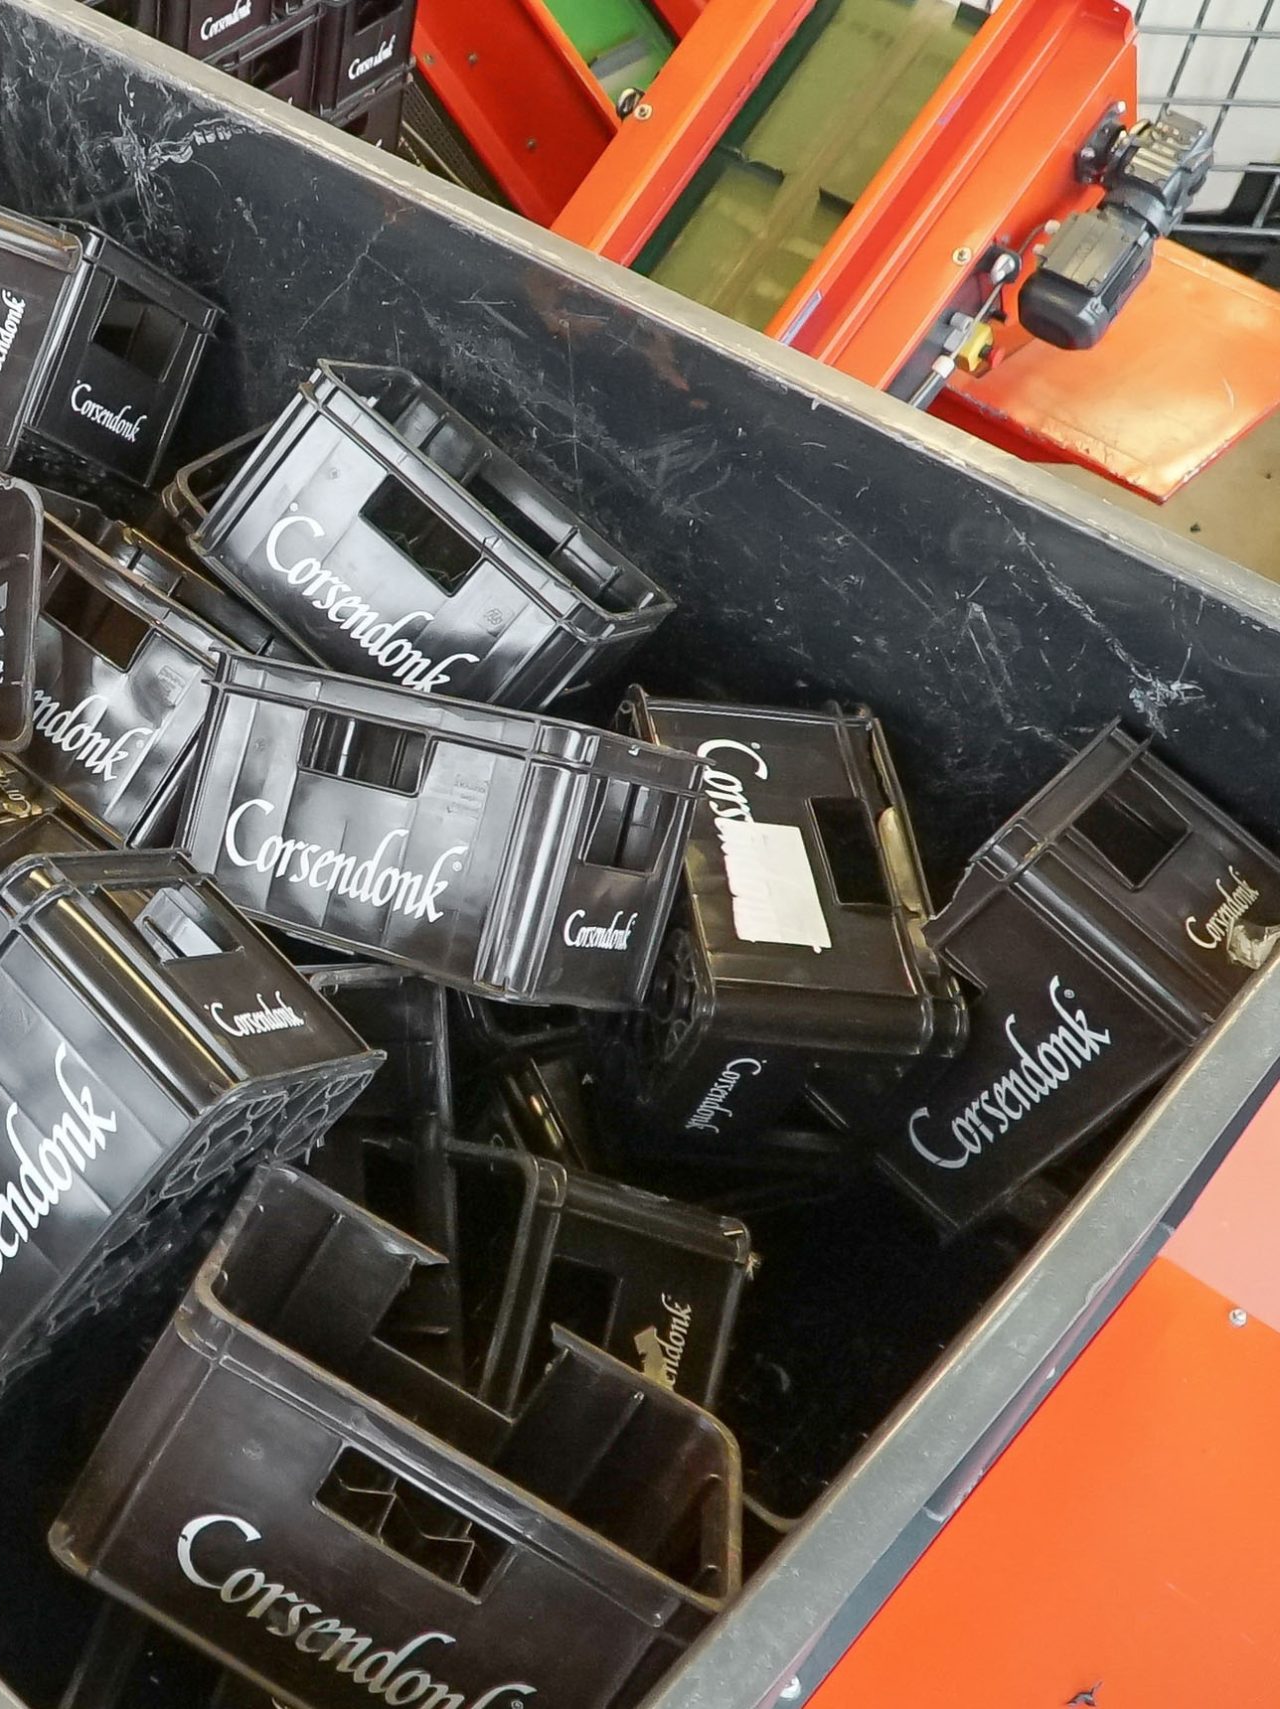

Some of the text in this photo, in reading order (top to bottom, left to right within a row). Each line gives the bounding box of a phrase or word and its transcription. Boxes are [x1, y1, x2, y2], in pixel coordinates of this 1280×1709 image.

[70, 382, 148, 444] Corsendonk
[265, 514, 482, 694] Corsendonk
[225, 799, 468, 923] Corsendonk
[563, 908, 638, 951] Corsendonk
[1185, 865, 1260, 949] Corsendonk
[209, 990, 305, 1037] Corsendonk
[685, 1058, 762, 1135] Corsendonk
[908, 975, 1112, 1170] Corsendonk
